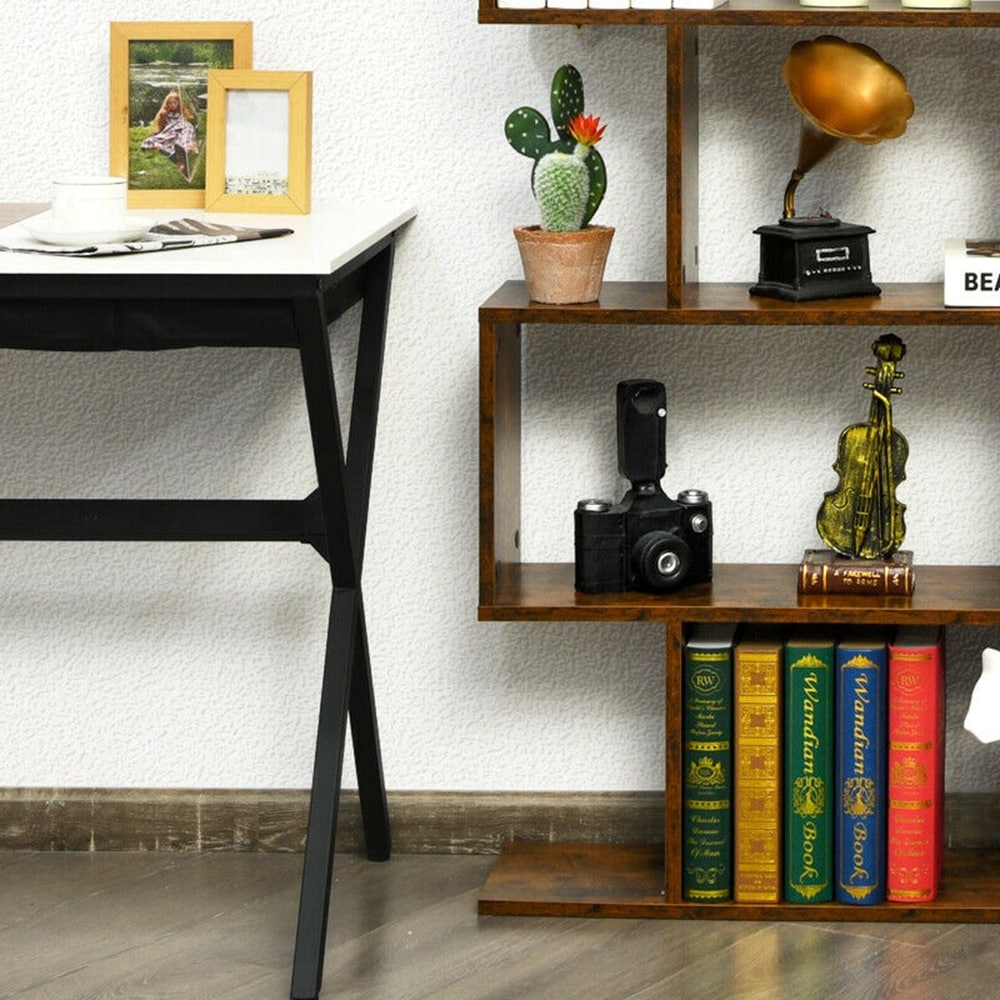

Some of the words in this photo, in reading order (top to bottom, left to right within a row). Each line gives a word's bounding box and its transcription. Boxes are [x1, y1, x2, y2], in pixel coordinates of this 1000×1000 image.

[843, 570, 881, 578] FAREWELL
[802, 672, 820, 775] Wandian
[852, 672, 871, 775] Wandian
[799, 822, 819, 884] Book
[849, 822, 869, 884] Book
